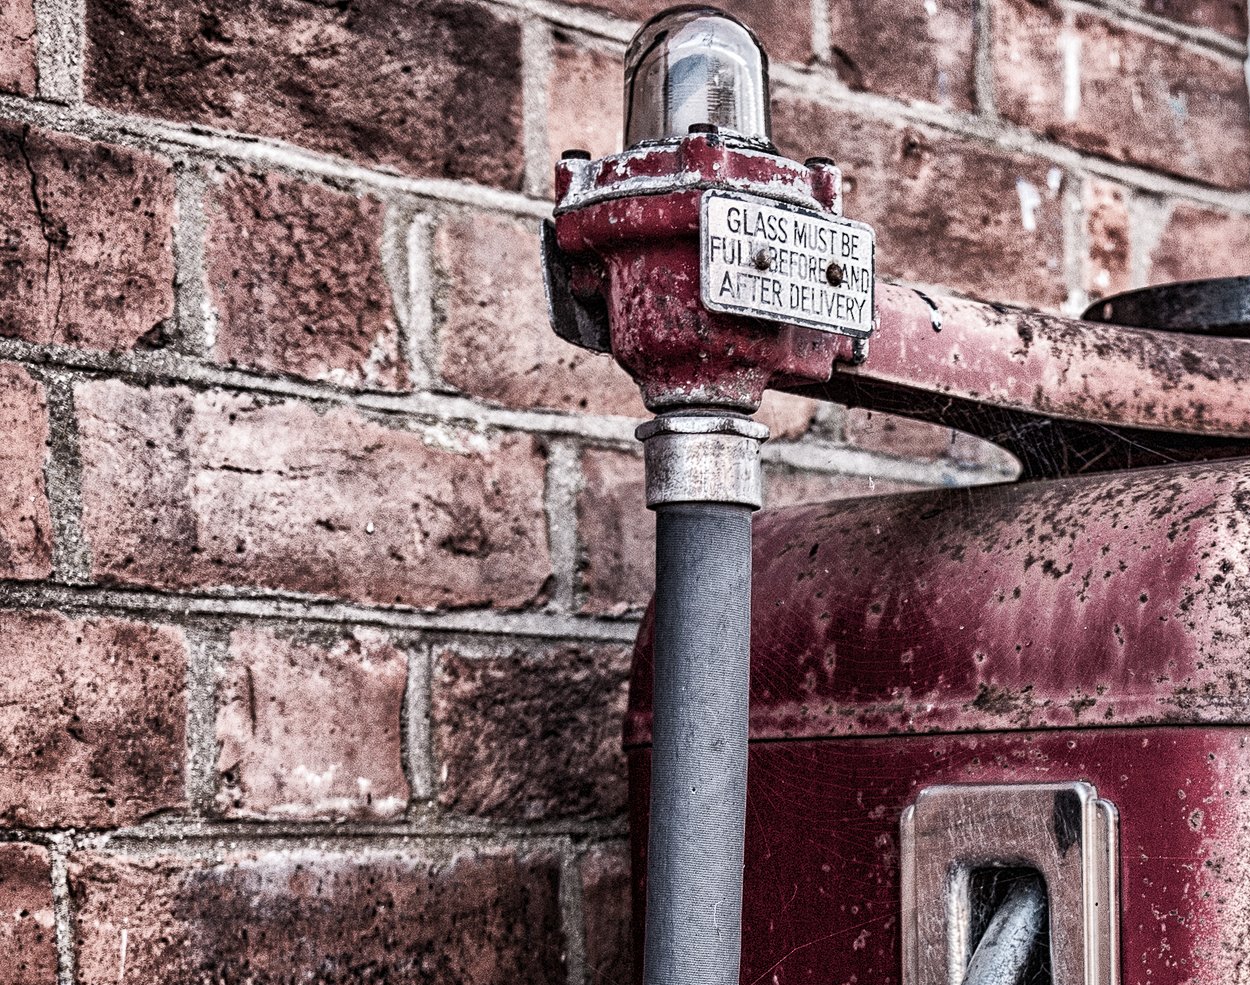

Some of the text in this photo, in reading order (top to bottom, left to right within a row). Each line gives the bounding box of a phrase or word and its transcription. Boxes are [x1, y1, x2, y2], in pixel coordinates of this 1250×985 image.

[727, 207, 860, 260] GLASS MUST BE
[768, 246, 827, 285] BEFORE
[839, 263, 870, 294] AND
[719, 271, 867, 324] AFTER DELIVERY
